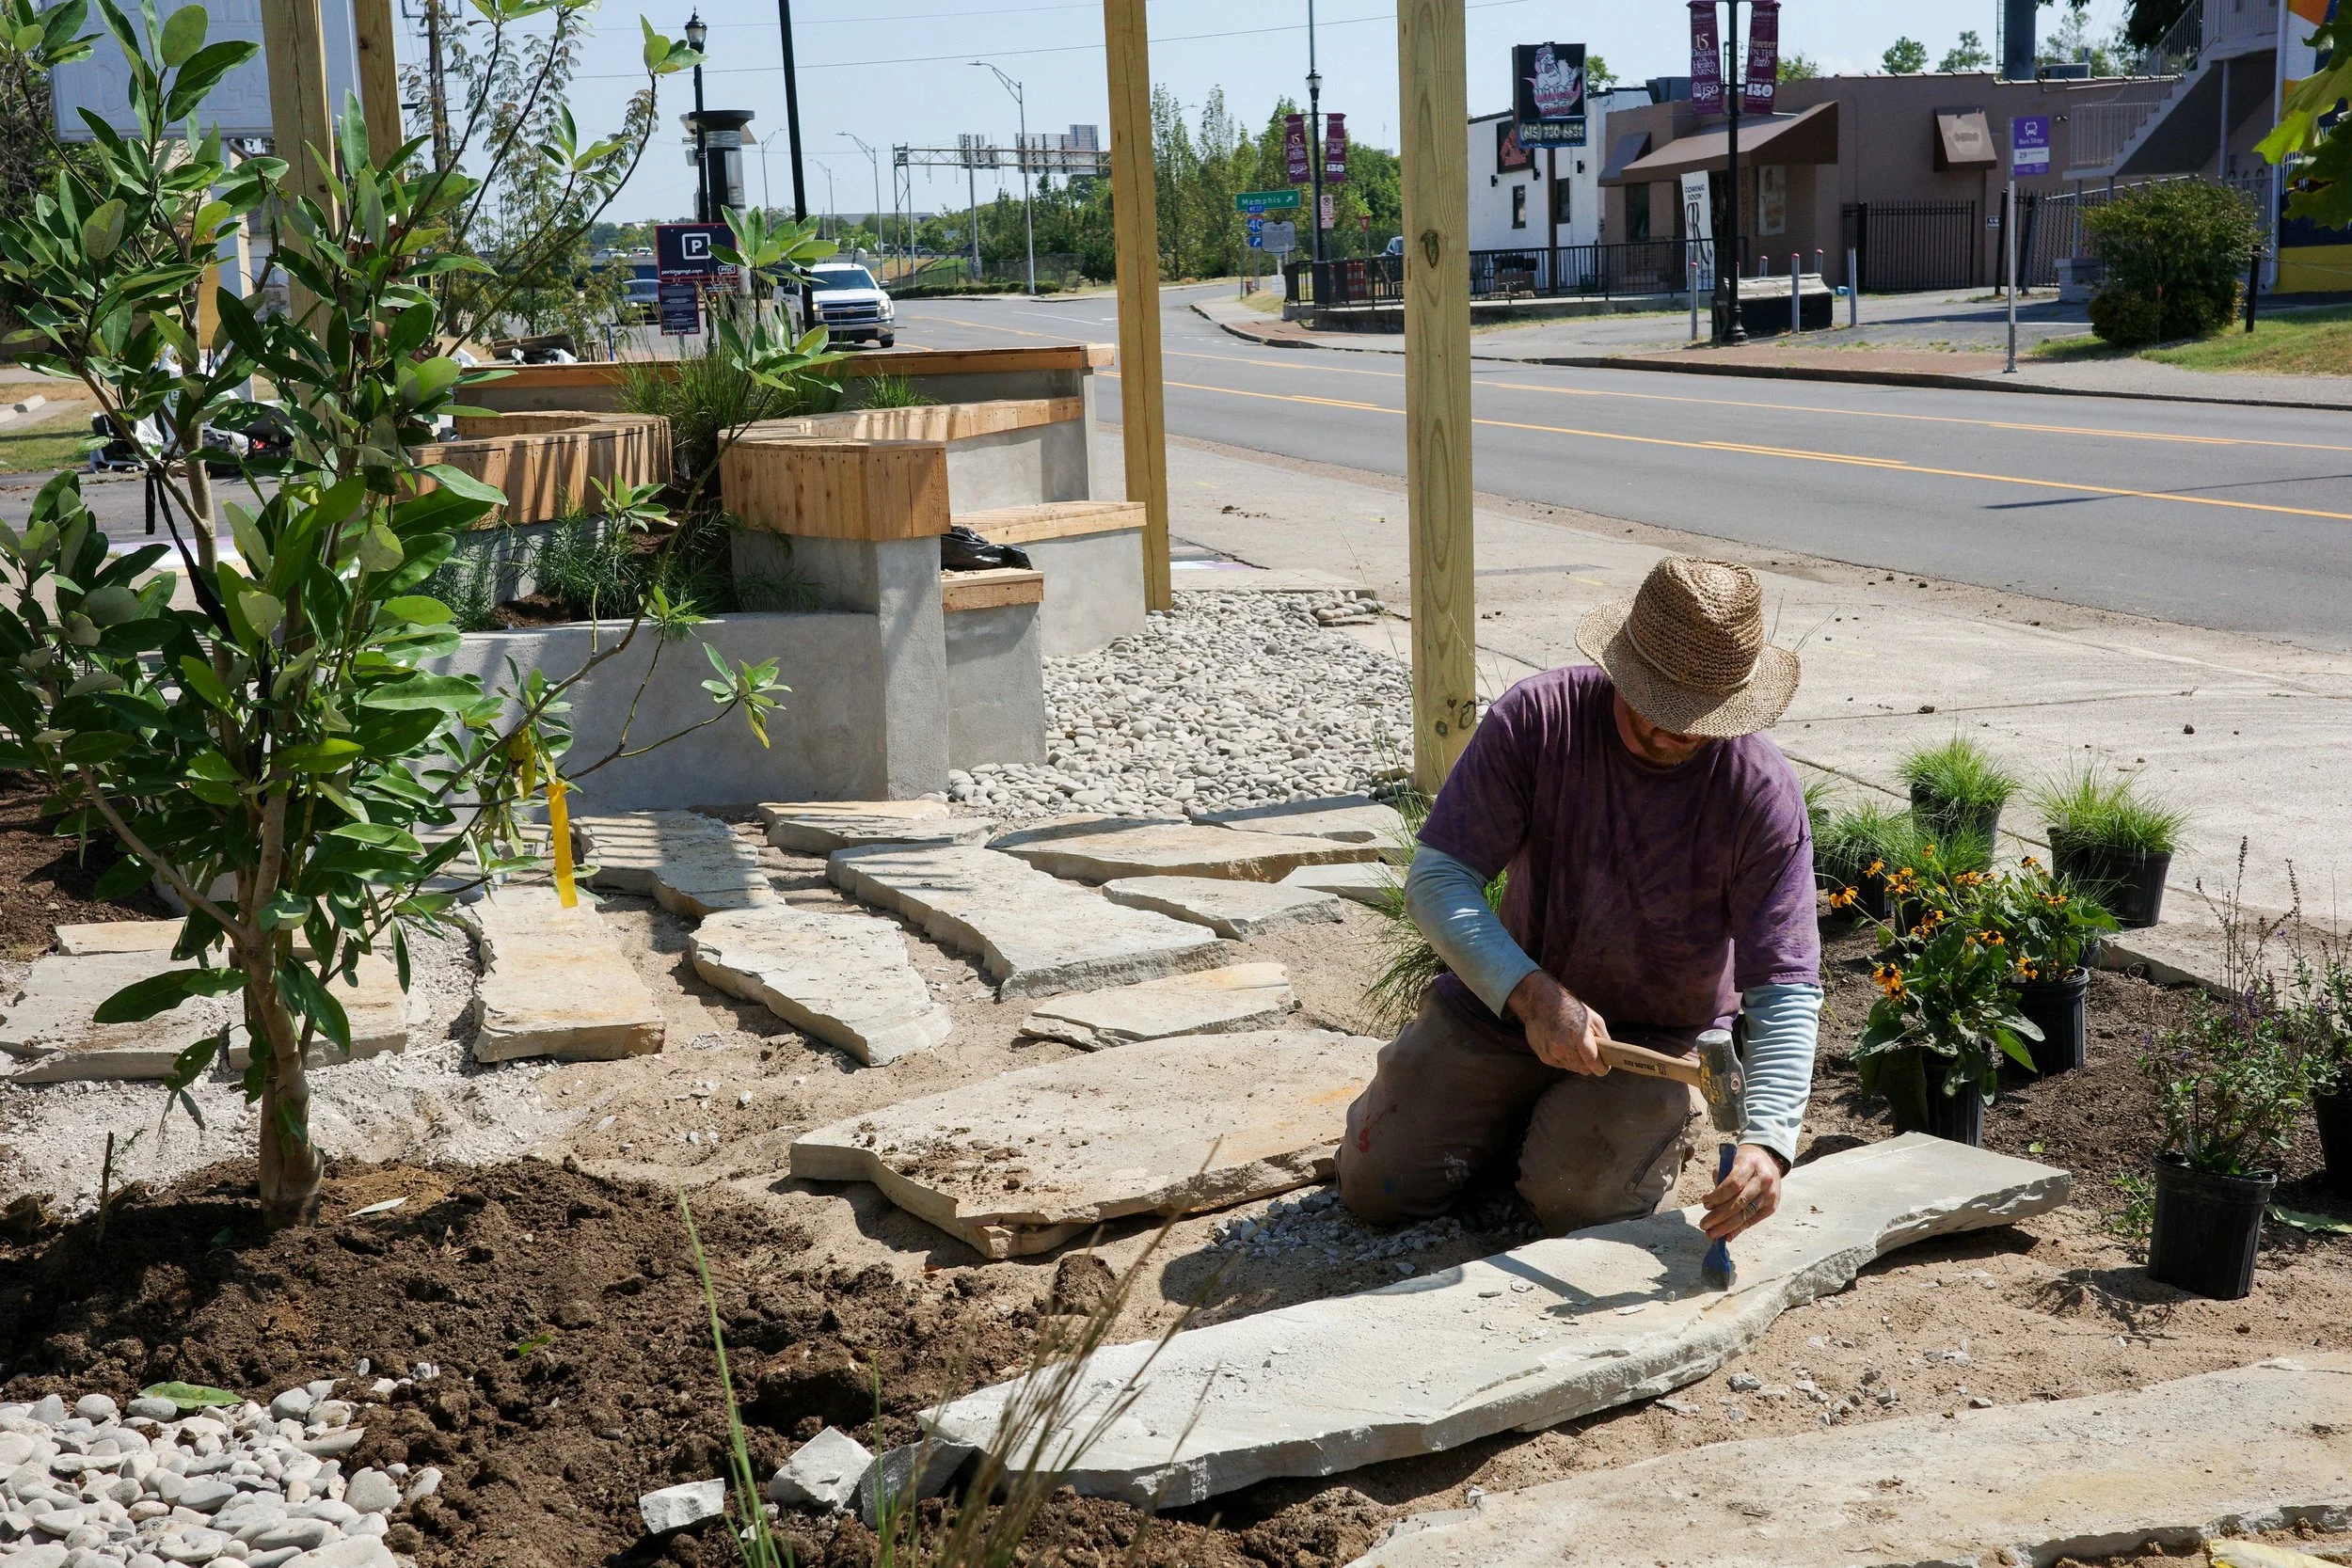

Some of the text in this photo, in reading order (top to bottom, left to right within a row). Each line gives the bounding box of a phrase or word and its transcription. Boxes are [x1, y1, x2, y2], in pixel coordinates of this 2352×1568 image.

[1694, 33, 1709, 51] 15
[1746, 84, 1773, 98] 150
[1520, 122, 1542, 141] (615)
[691, 239, 703, 253] P
